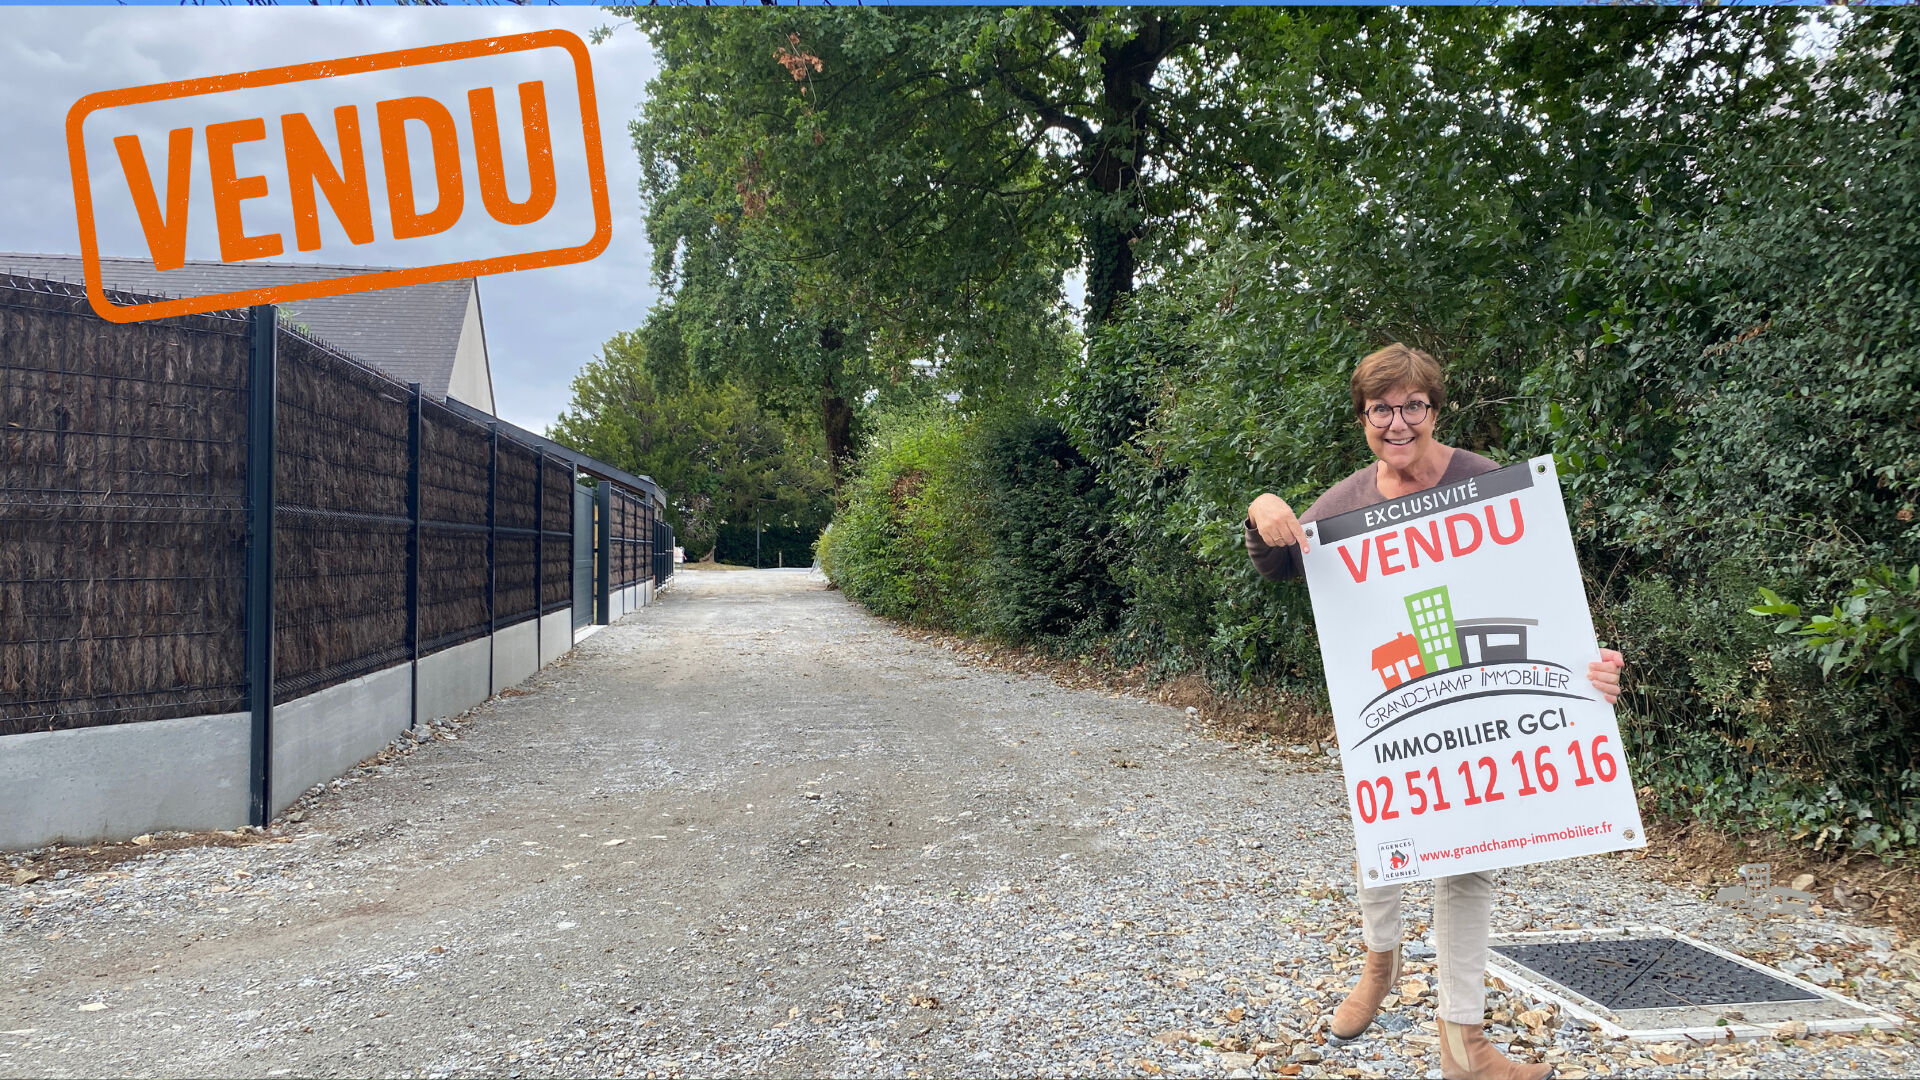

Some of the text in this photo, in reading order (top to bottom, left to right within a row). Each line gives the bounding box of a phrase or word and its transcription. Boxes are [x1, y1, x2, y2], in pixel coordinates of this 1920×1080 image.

[1364, 477, 1479, 528] EXCLUSIVITÉ
[1337, 498, 1525, 584] VENDU
[1365, 674, 1473, 730] GRANDCHAMP
[1374, 718, 1511, 764] IMMOBILIER
[1356, 734, 1617, 824] 02 51 12 16 16
[1380, 841, 1412, 851] AGENCES
[1419, 821, 1613, 863] www.grandchamp-immobilier.fr
